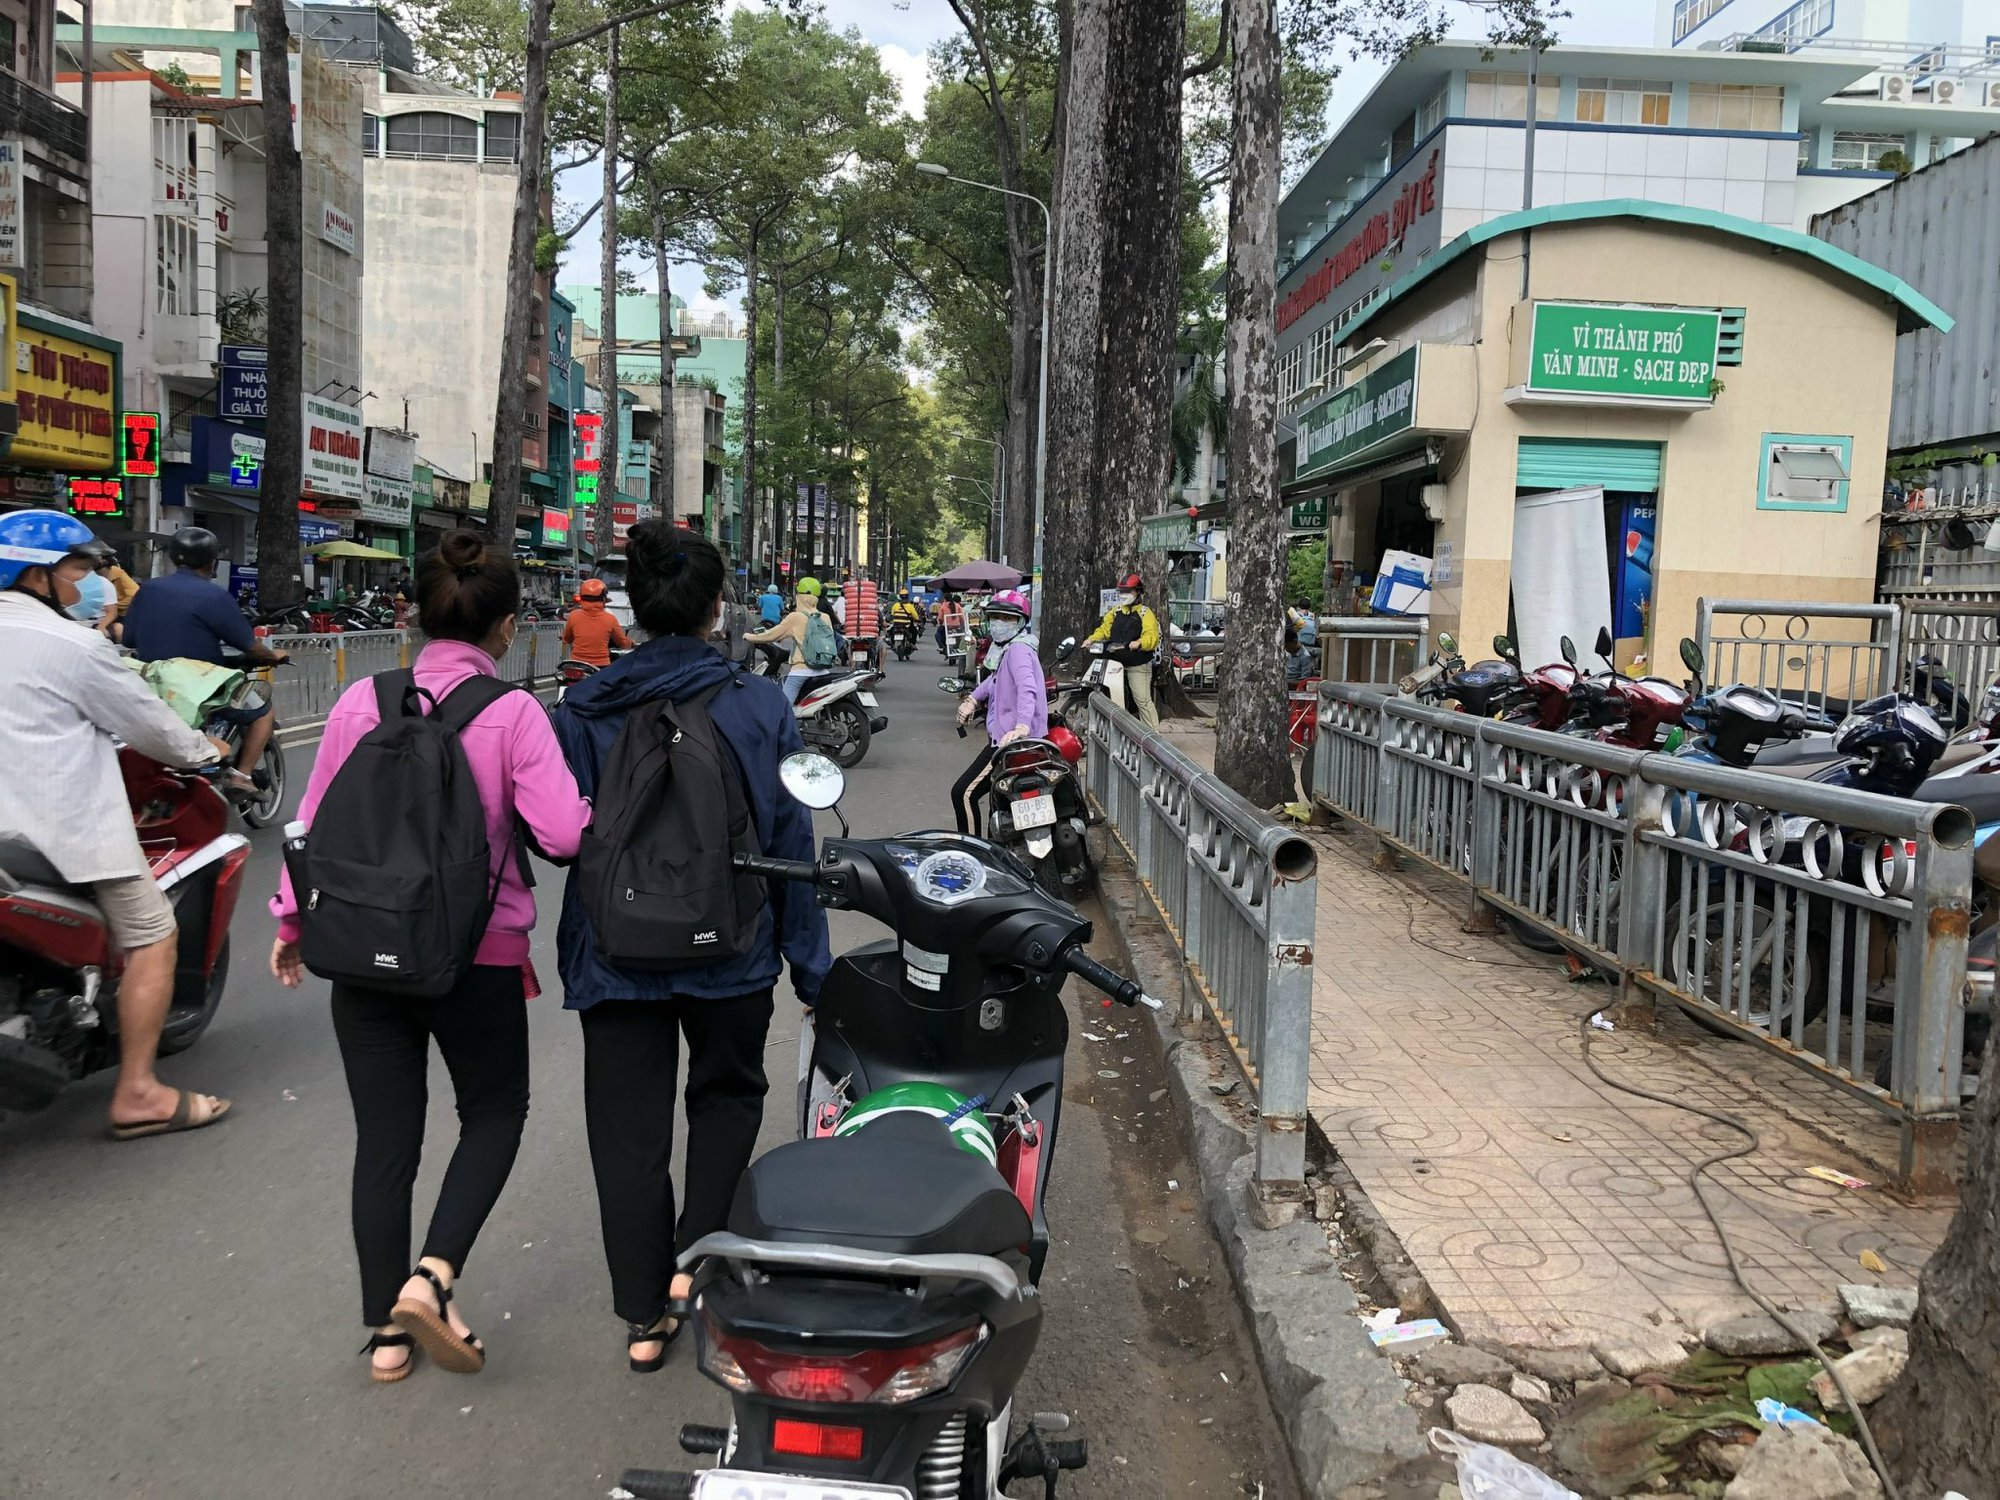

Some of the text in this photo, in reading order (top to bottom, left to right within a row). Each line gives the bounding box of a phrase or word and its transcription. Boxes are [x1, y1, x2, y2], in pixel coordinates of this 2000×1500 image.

[0, 145, 14, 162] AL
[1392, 182, 1408, 241] BỘ
[1408, 182, 1420, 224] Y
[1419, 149, 1440, 217] TẾ
[1573, 321, 1685, 354] VÌ THÀNH PHỐ
[1543, 348, 1573, 376] VĂN
[1577, 355, 1620, 379] MINH
[1633, 358, 1675, 386] SẠCH
[1678, 361, 1710, 388] ĐẸP
[240, 370, 267, 384] NHÀ
[232, 384, 267, 399] THUỐ
[254, 399, 267, 415] TỐ
[1356, 399, 1375, 432] MINH
[1377, 385, 1397, 427] SẠCH
[1397, 379, 1412, 417] ĐẸP
[309, 425, 327, 453] AN
[328, 430, 360, 461] NHÂN
[1633, 507, 1656, 518] PEP
[1299, 515, 1320, 527] WC
[693, 931, 717, 942] MWC
[375, 953, 398, 964] MWC
